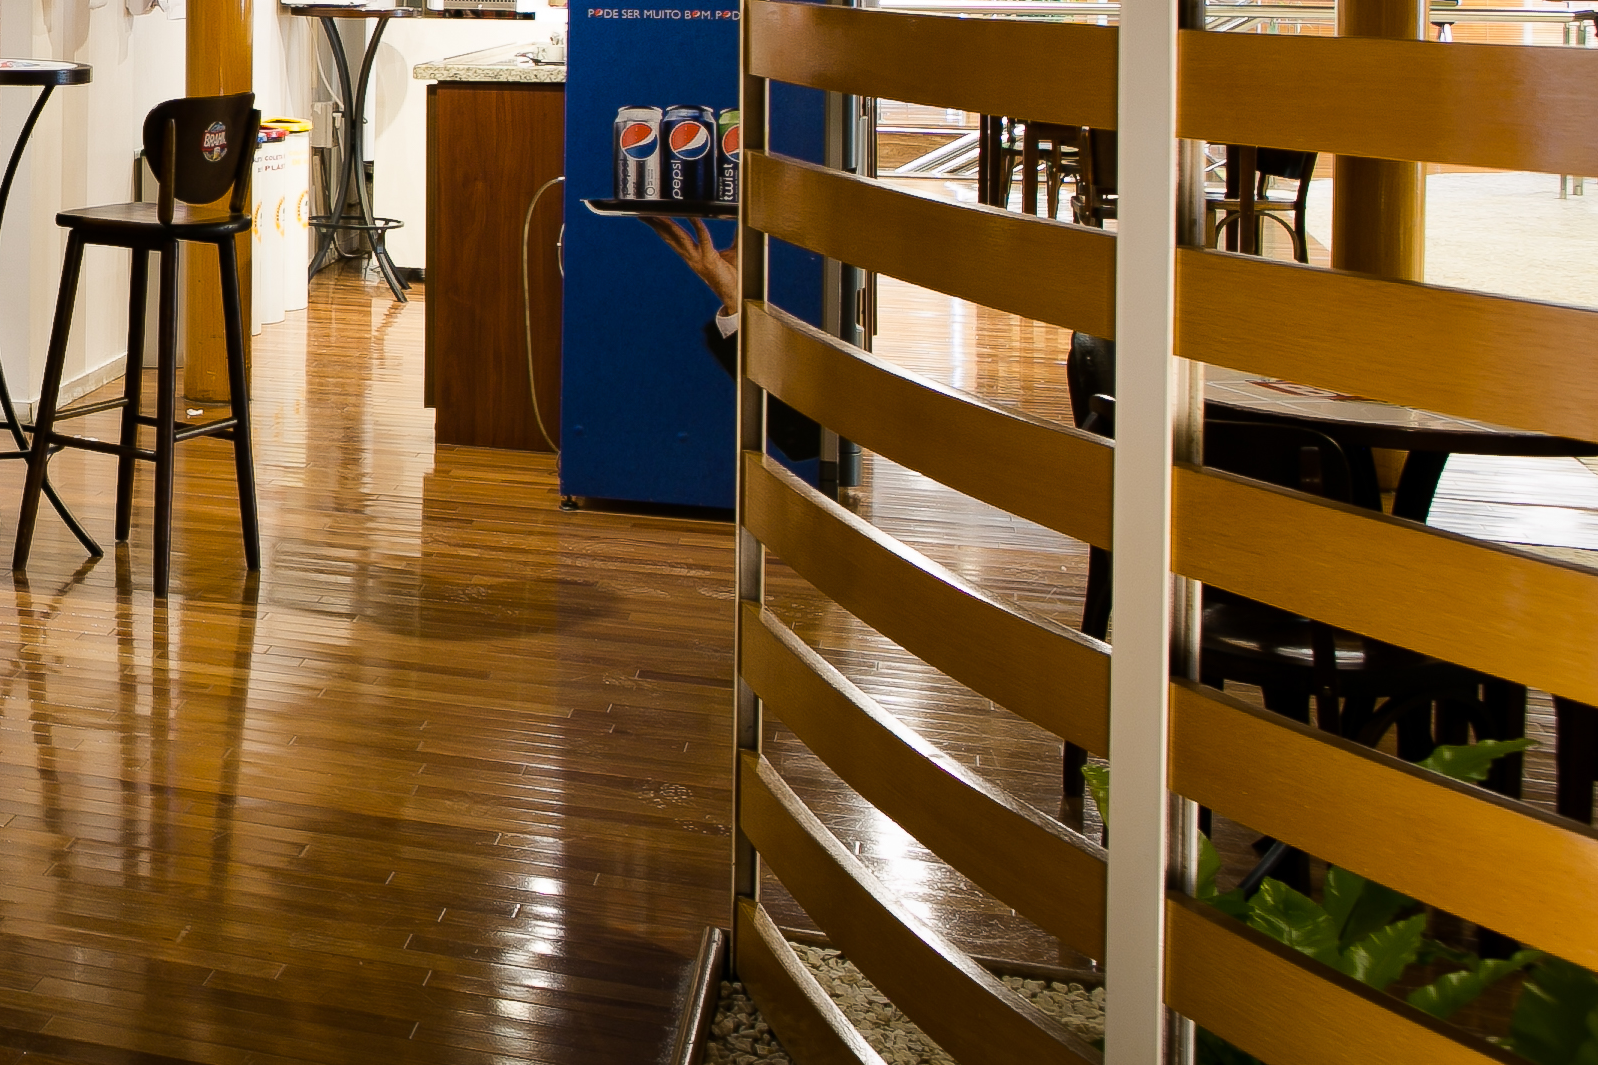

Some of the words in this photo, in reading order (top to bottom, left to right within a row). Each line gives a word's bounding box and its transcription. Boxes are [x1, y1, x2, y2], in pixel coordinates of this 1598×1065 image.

[621, 9, 640, 19] SER
[643, 9, 681, 20] MUITO
[715, 10, 740, 21] POD
[670, 159, 684, 200] pepsi
[723, 163, 734, 201] twist
